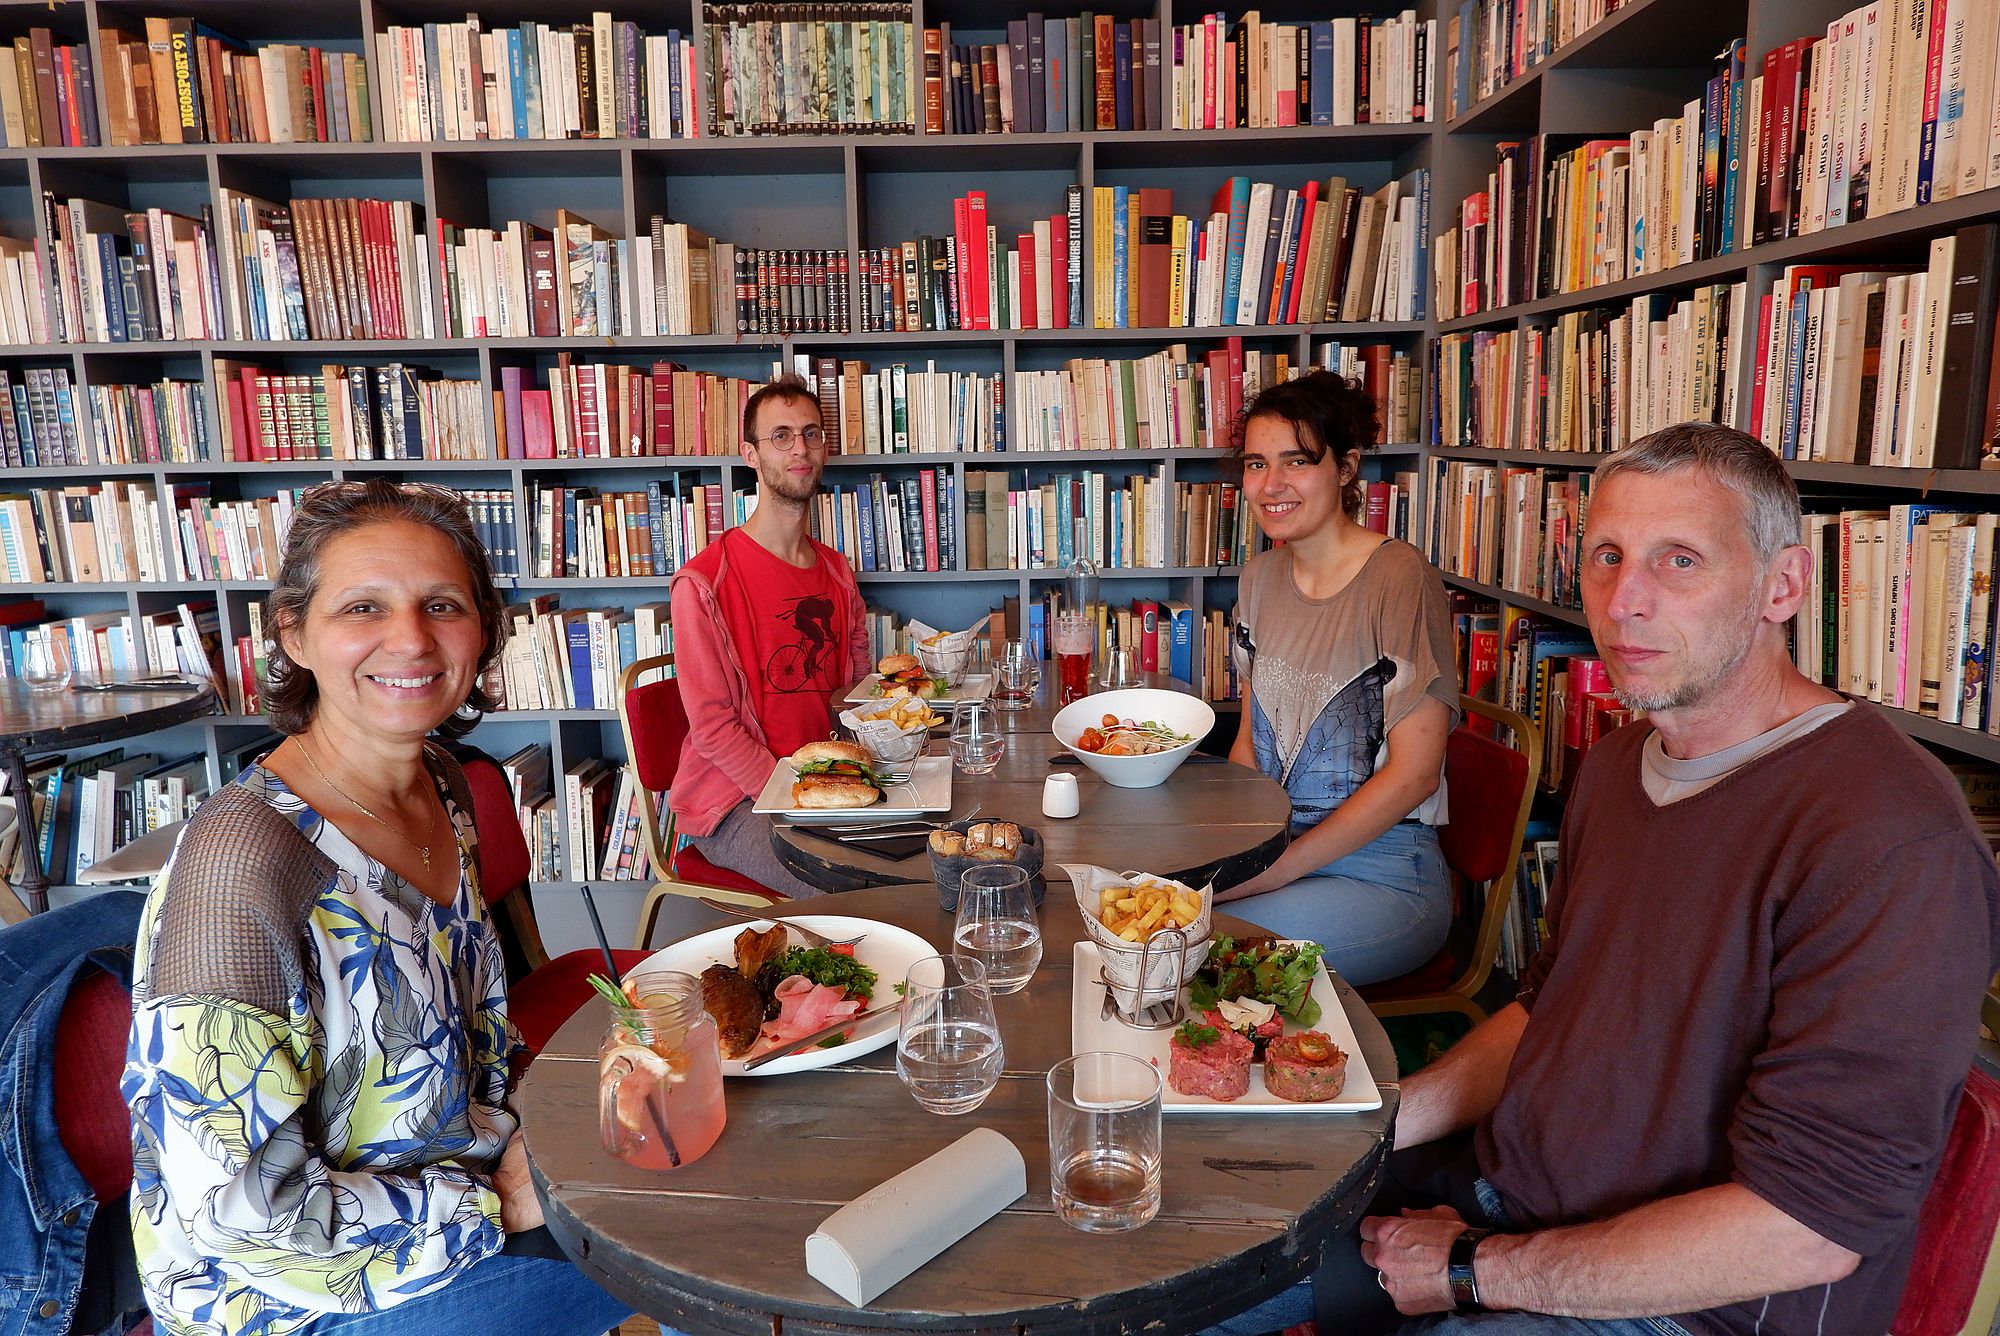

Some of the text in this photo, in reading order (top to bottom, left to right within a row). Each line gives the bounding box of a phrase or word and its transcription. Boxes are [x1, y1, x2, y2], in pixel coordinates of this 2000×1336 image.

[172, 33, 195, 128] DICOSPORT 91
[580, 44, 589, 98] LA CHASSE
[1843, 48, 1851, 84] papier
[1943, 18, 1964, 140] Les enfants de la liberté
[460, 88, 468, 112] MICHEL
[1708, 83, 1720, 133] L'idéaliste
[1752, 82, 1760, 126] renaissance
[1862, 79, 1873, 112] L'appel
[1674, 124, 1682, 145] 1989
[1809, 106, 1817, 136] COFFE
[1924, 122, 1934, 142] pour
[1750, 136, 1757, 148] De
[1760, 110, 1772, 186] La première nuit
[1777, 105, 1790, 178] Le premier jour
[1818, 134, 1829, 174] MUSSO
[1857, 122, 1868, 162] MUSSO
[1834, 142, 1844, 180] MUSSO
[73, 210, 81, 220] Les
[1068, 192, 1080, 239] ET LA TERRE
[1422, 202, 1430, 226] monde
[262, 240, 271, 258] SKY
[1420, 227, 1428, 249] vivant
[1670, 224, 1678, 250] GUIDE
[340, 218, 358, 298] LES MONDES ANTIQUES
[1228, 256, 1239, 298] LES TABLES
[1774, 300, 1782, 330] SYNDICATS
[1770, 342, 1778, 370] DICTATURE
[1806, 315, 1818, 380] de la roche
[1925, 300, 1938, 376] géographie sociale
[1693, 314, 1706, 414] GUERRE ET LA PAIX
[1755, 365, 1764, 386] Fati
[1770, 370, 1776, 378] LA
[1610, 390, 1618, 427] MARS
[1782, 387, 1795, 444] L'enfant au
[1801, 420, 1809, 434] de
[938, 468, 946, 480] JEUX
[862, 506, 870, 538] ASSASSIN
[1842, 518, 1850, 608] LA MAIN D'ABRAHAM
[594, 621, 603, 642] RIKA
[82, 784, 90, 824] LAROUSSE
[612, 826, 623, 850] COLONEL
